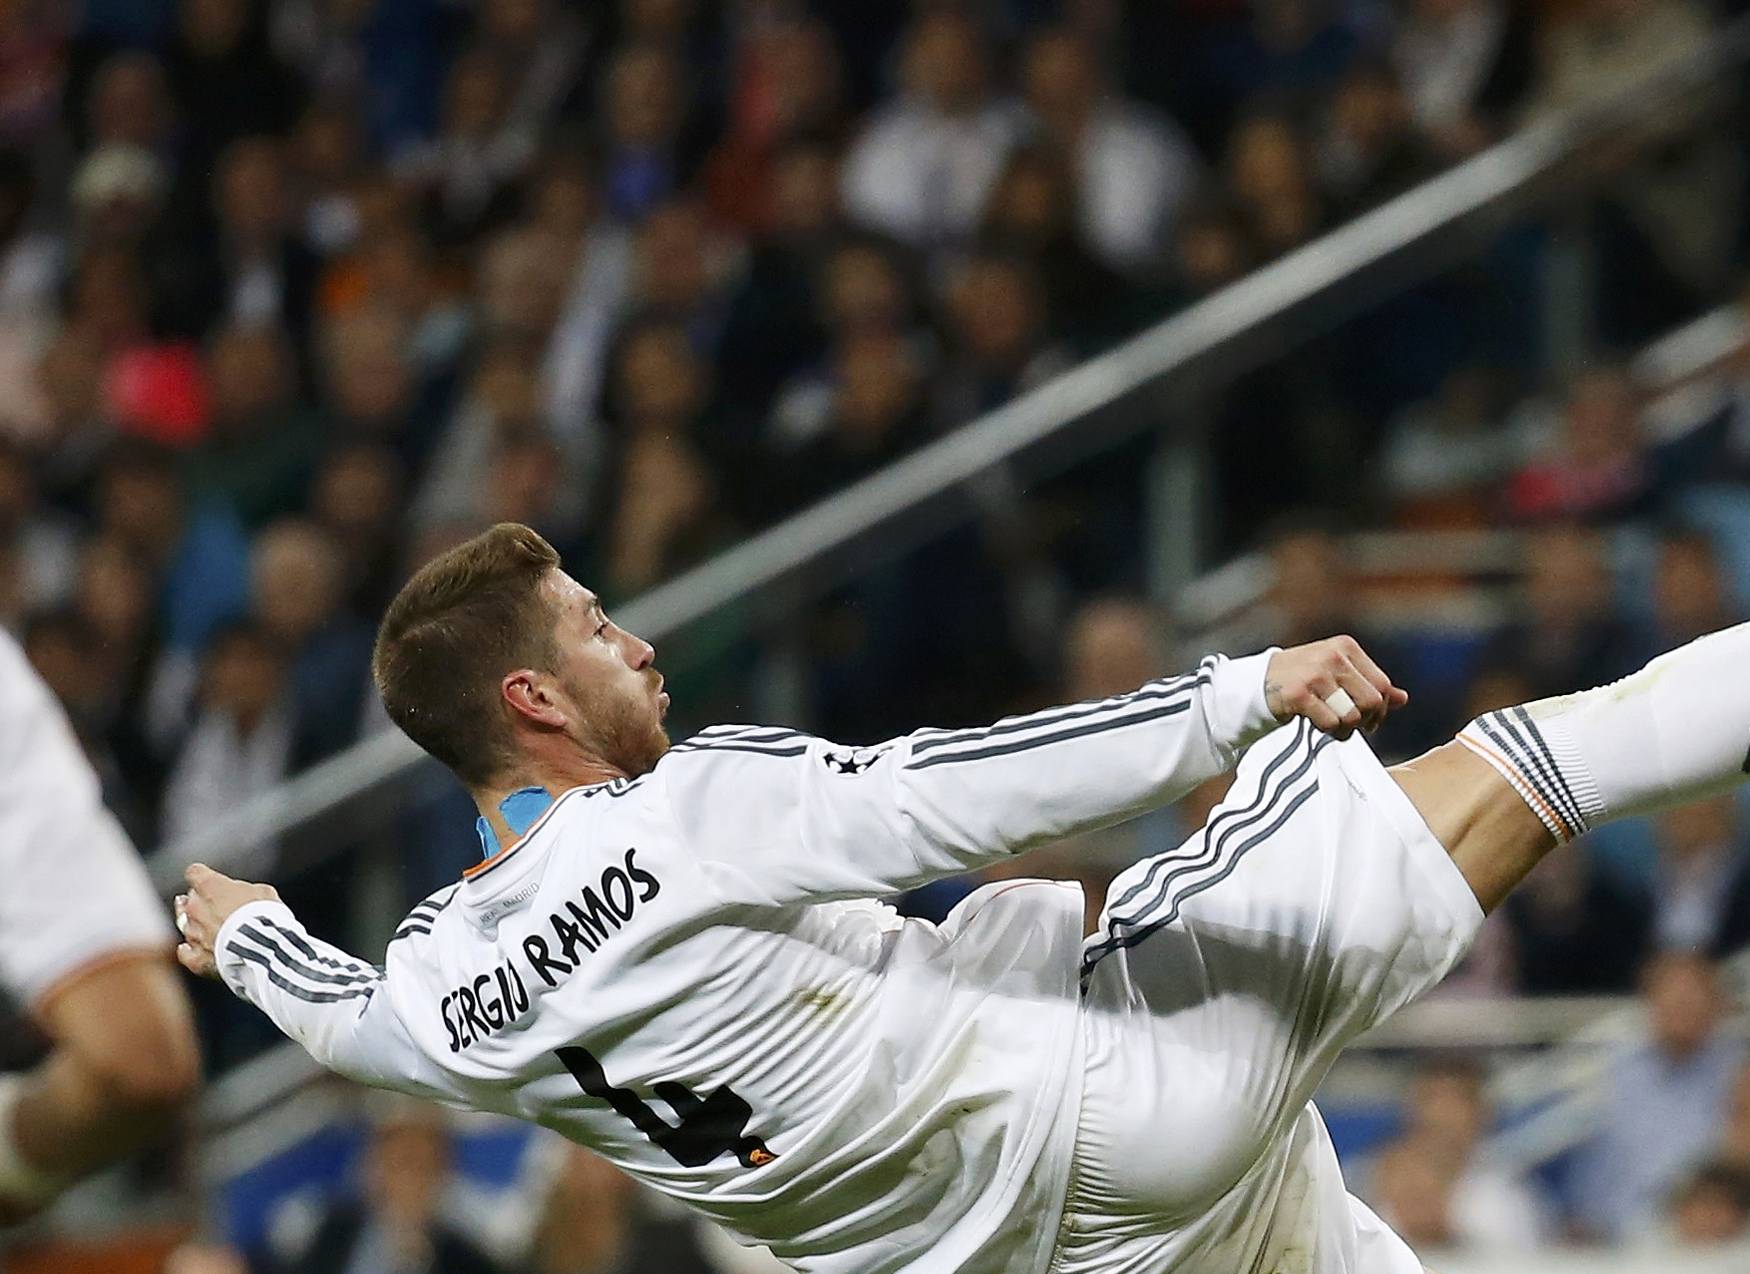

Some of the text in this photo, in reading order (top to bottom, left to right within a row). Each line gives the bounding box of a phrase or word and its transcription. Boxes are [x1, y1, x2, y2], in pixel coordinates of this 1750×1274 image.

[441, 848, 660, 1052] SERGIO RAMOS
[554, 1045, 780, 1168] 4
